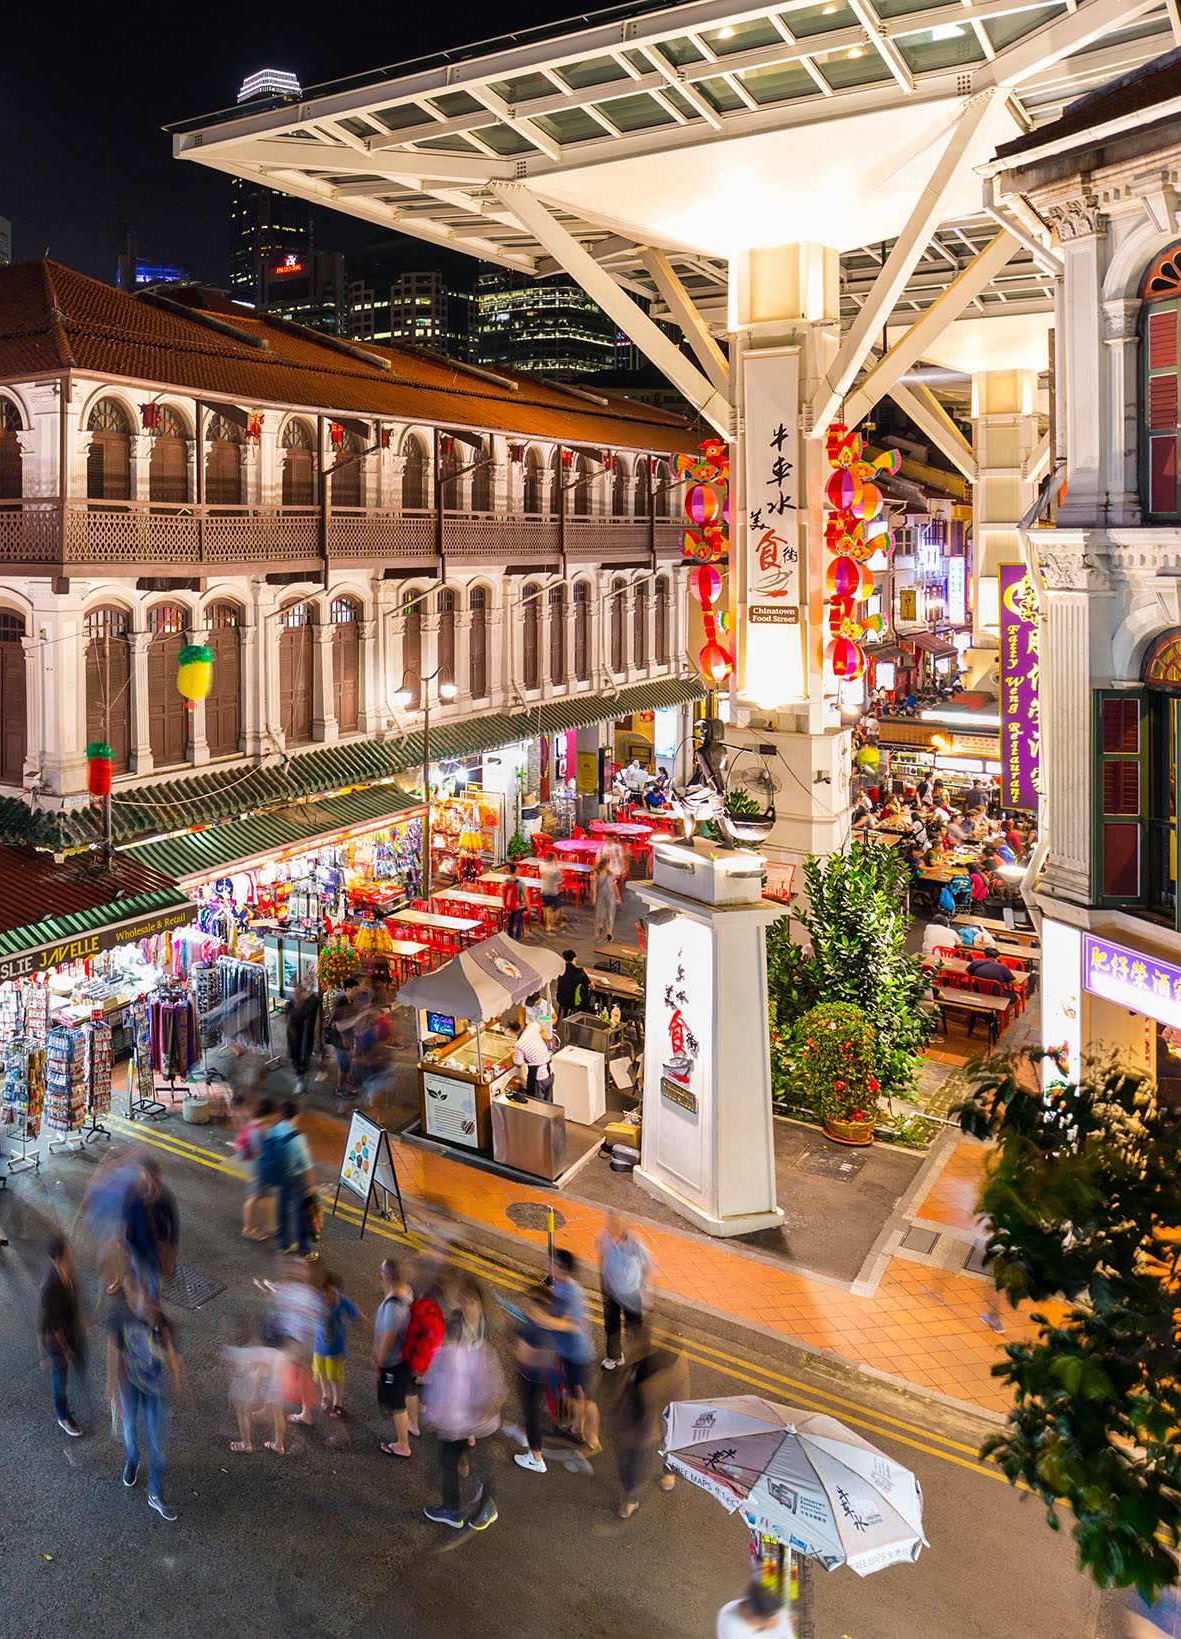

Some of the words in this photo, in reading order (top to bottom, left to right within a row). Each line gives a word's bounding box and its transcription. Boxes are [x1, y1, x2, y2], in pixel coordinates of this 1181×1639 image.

[752, 607, 795, 615] Chinatown
[772, 615, 796, 623] Street
[1006, 624, 1021, 670] Fatty
[1005, 676, 1025, 714] Weng
[1007, 722, 1024, 803] Restaurant
[39, 936, 100, 968] JAVELLE
[115, 925, 156, 942] Wholesale
[156, 920, 163, 929] &
[164, 912, 186, 927] Retail
[690, 1473, 713, 1491] MAPS
